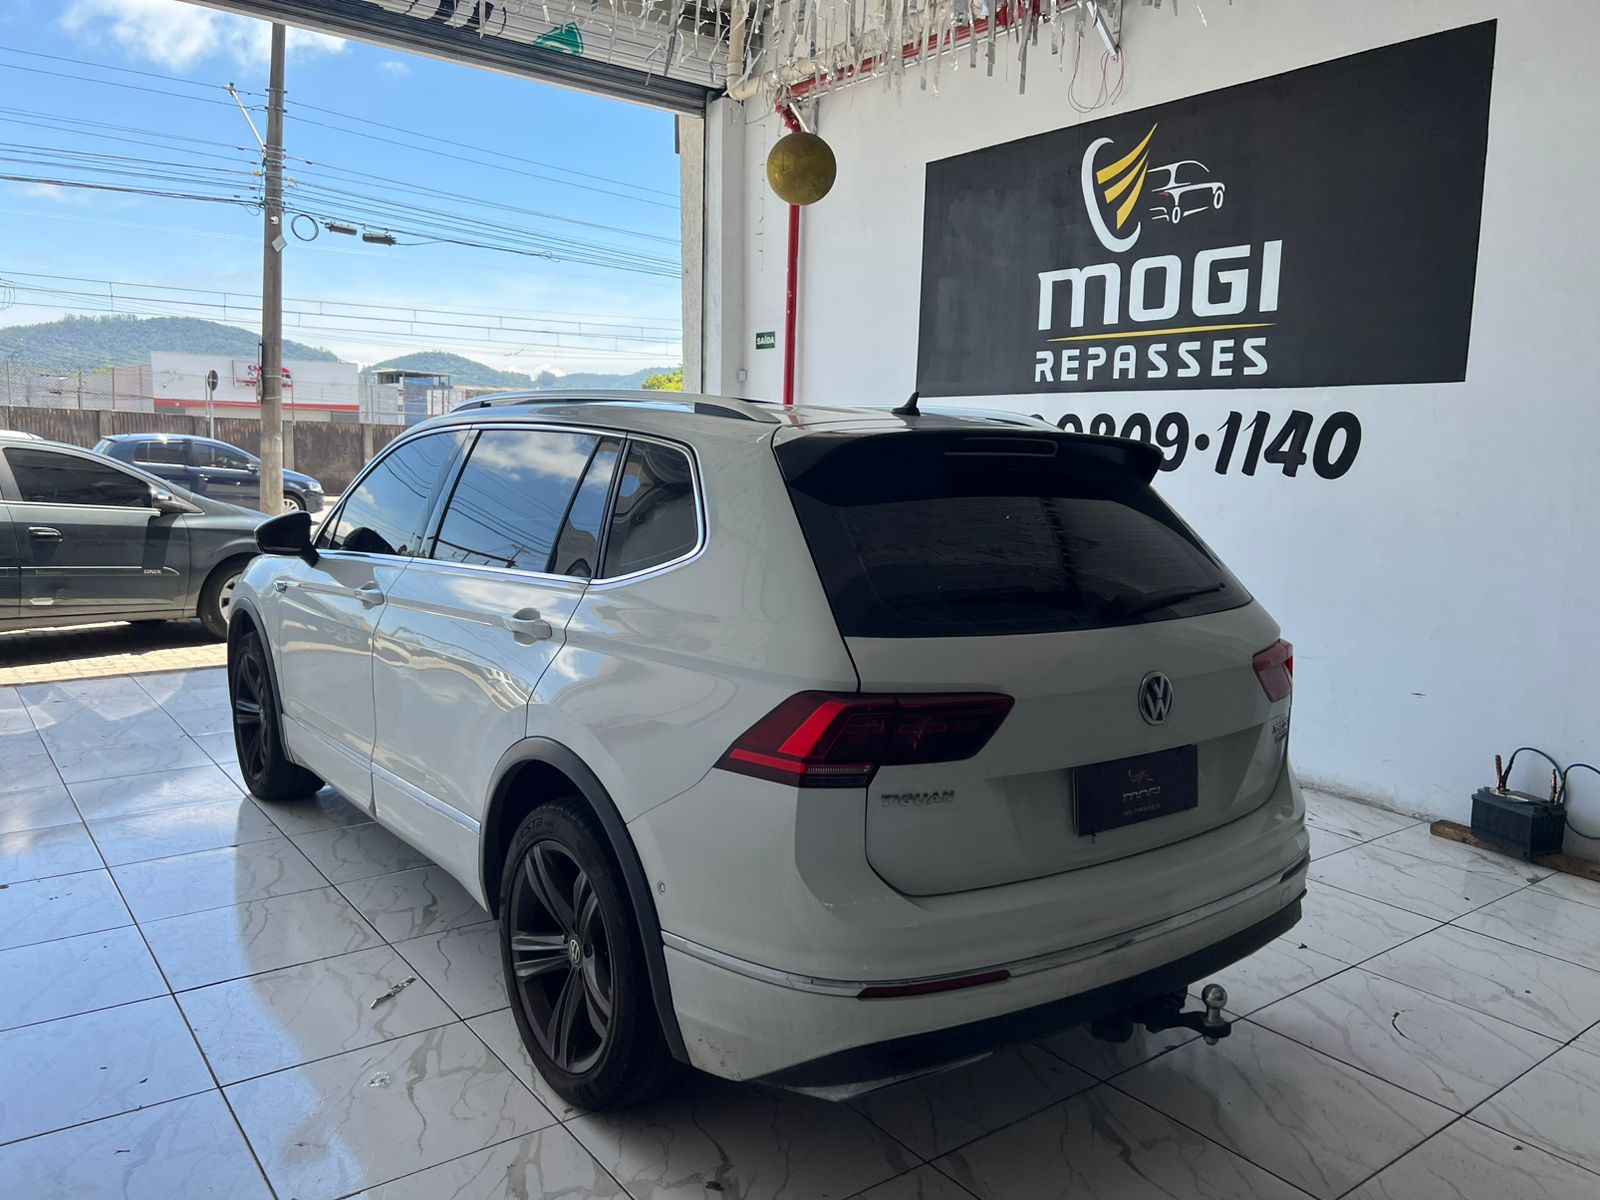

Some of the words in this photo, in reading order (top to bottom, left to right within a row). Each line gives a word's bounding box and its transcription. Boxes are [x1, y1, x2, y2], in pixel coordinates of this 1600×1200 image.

[1037, 239, 1283, 331] MOGI
[756, 334, 775, 345] SAÍDA
[1034, 337, 1269, 383] REPASSES
[881, 789, 956, 807] TIGUAN
